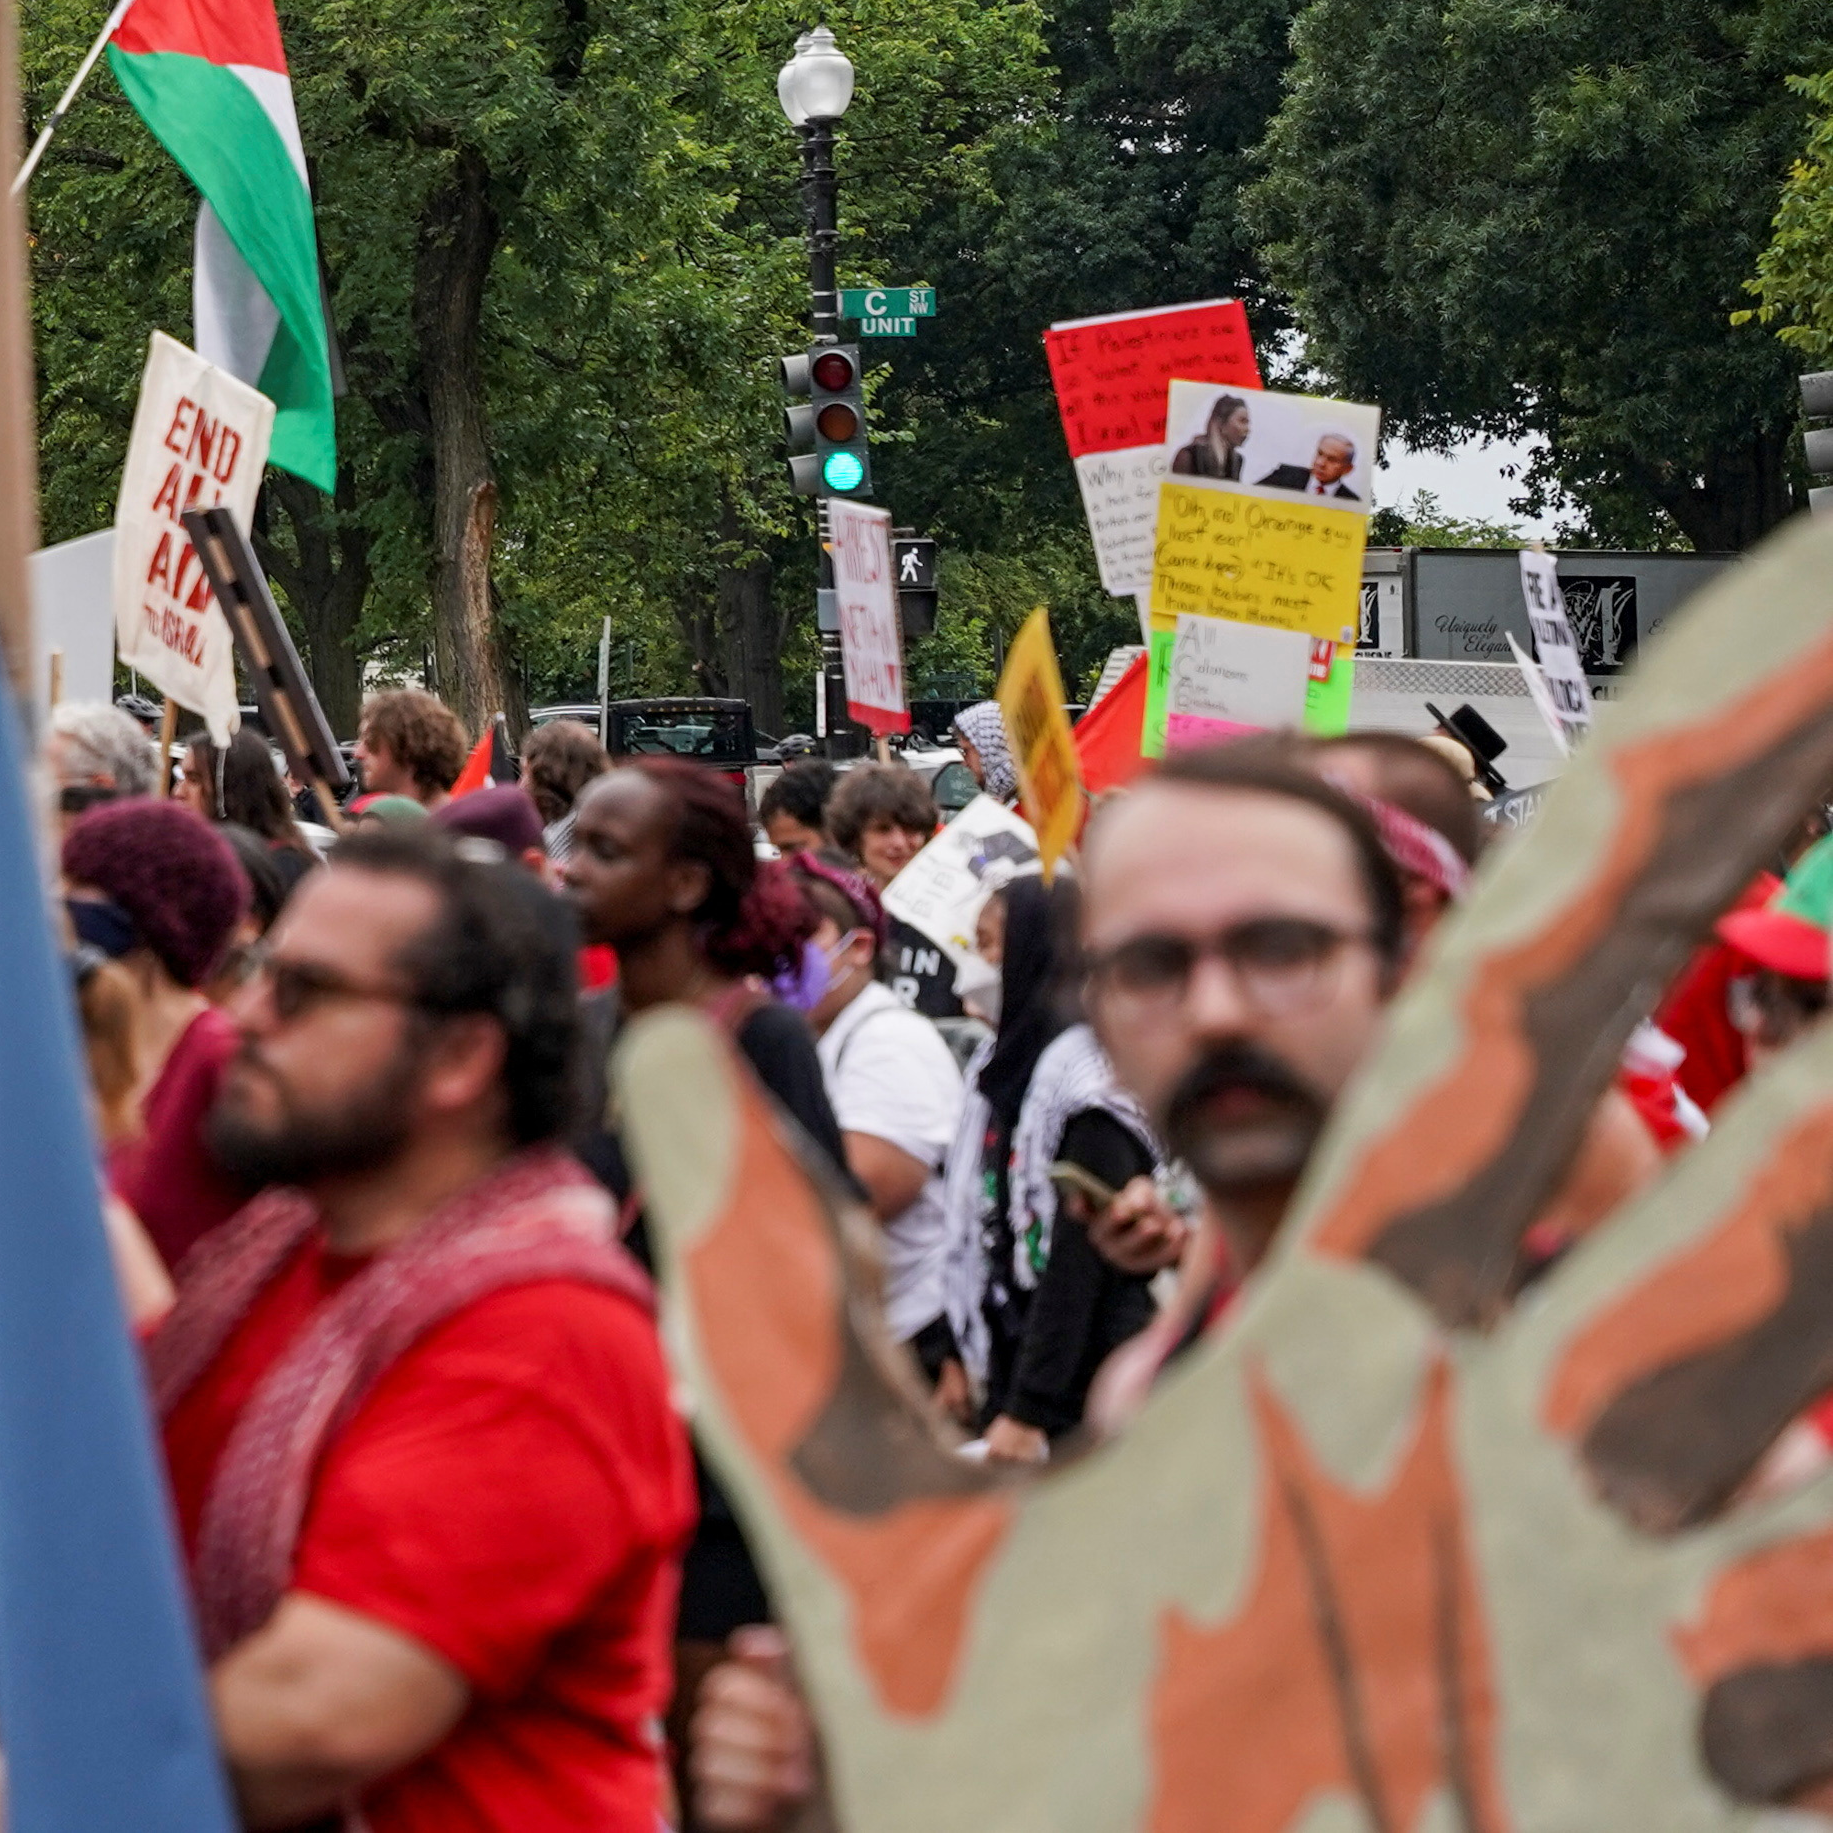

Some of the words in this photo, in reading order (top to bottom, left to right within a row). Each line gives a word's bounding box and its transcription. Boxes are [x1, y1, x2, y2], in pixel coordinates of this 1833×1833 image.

[864, 291, 887, 316] C
[909, 290, 931, 303] ST
[909, 303, 929, 315] NW
[861, 317, 915, 335] UNIT
[164, 395, 242, 485] END
[1434, 614, 1499, 640] Uniquely
[900, 946, 942, 977] IN
